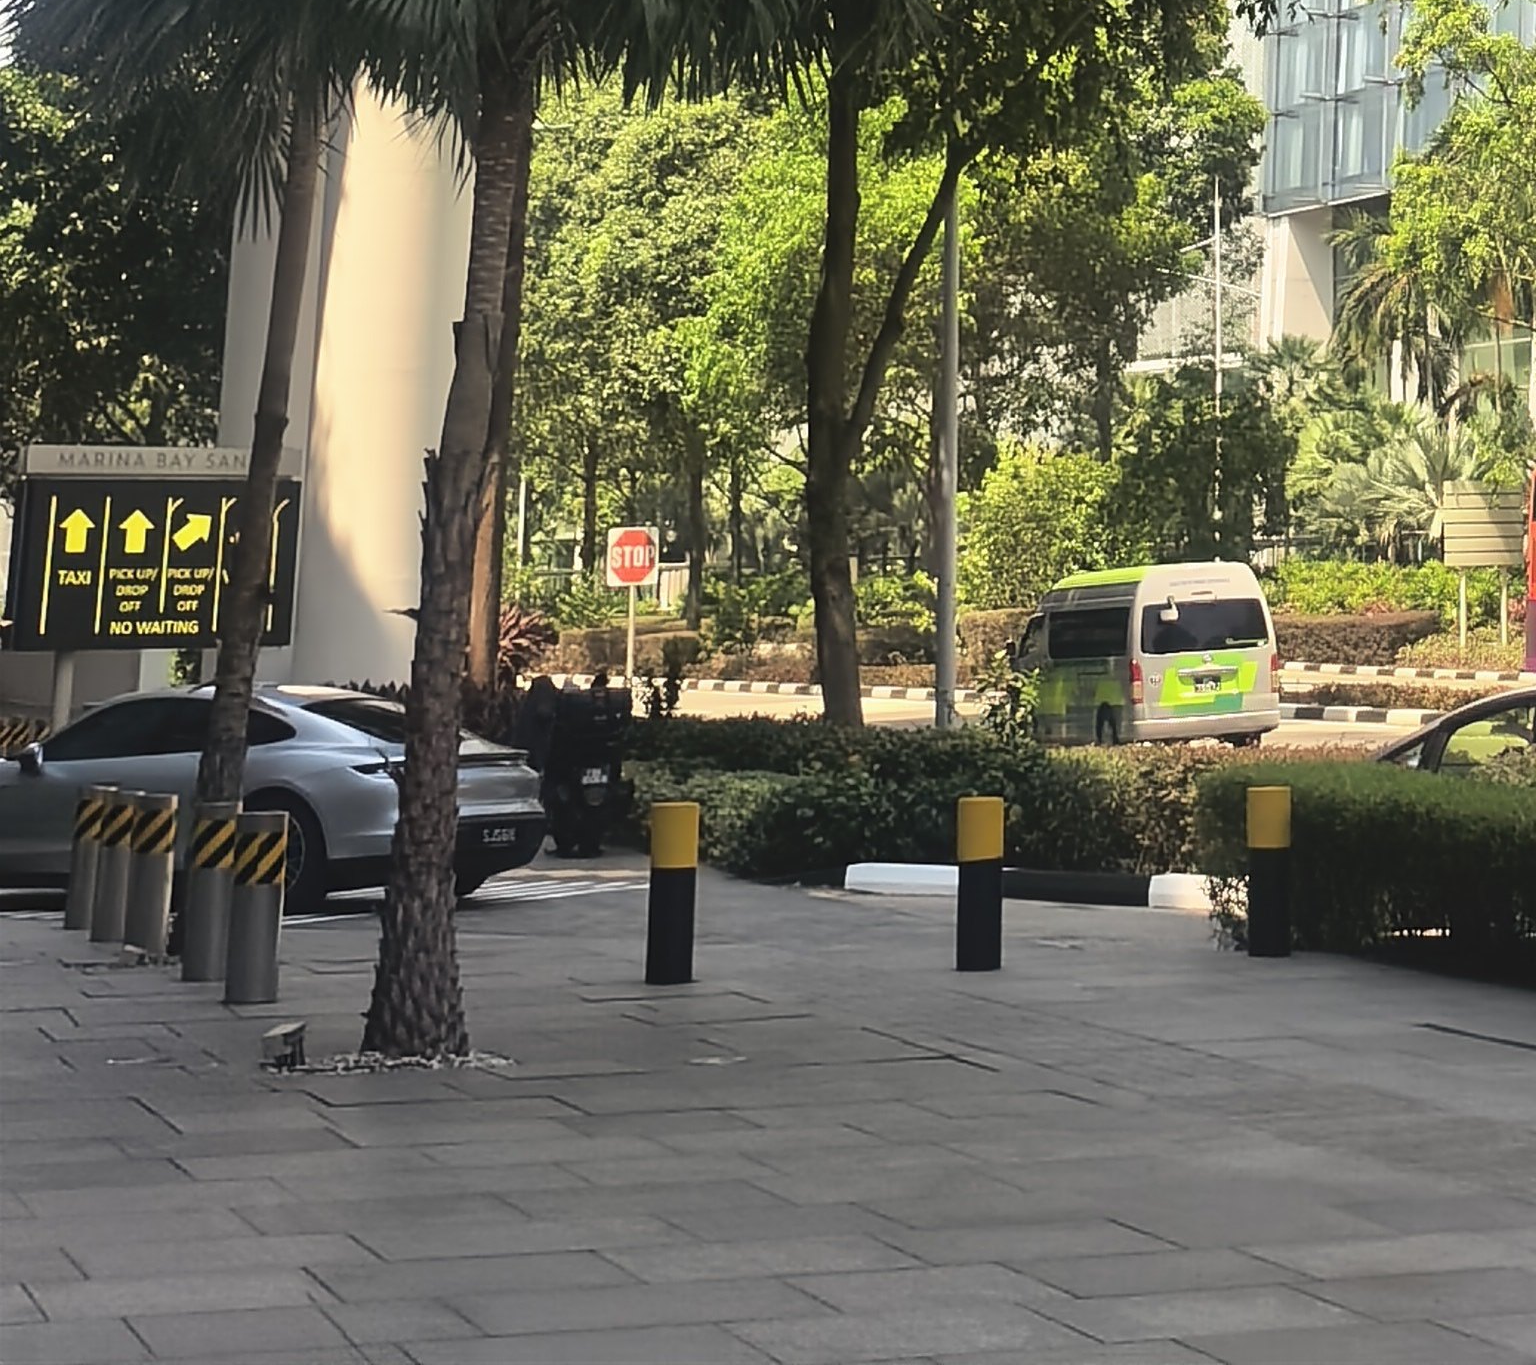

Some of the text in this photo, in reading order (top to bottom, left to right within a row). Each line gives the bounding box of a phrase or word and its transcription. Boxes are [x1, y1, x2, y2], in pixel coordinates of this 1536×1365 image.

[58, 452, 247, 469] MARINA BAY SAN
[611, 545, 655, 569] STOP
[58, 570, 92, 585] TAXI
[109, 568, 159, 581] PICK UP/
[167, 569, 192, 580] PICK
[194, 568, 215, 581] UP/
[115, 585, 149, 597] DROP
[173, 585, 206, 597] DROP
[119, 601, 142, 613] OFF
[177, 601, 199, 612] OFF
[109, 620, 199, 635] NO WAITING
